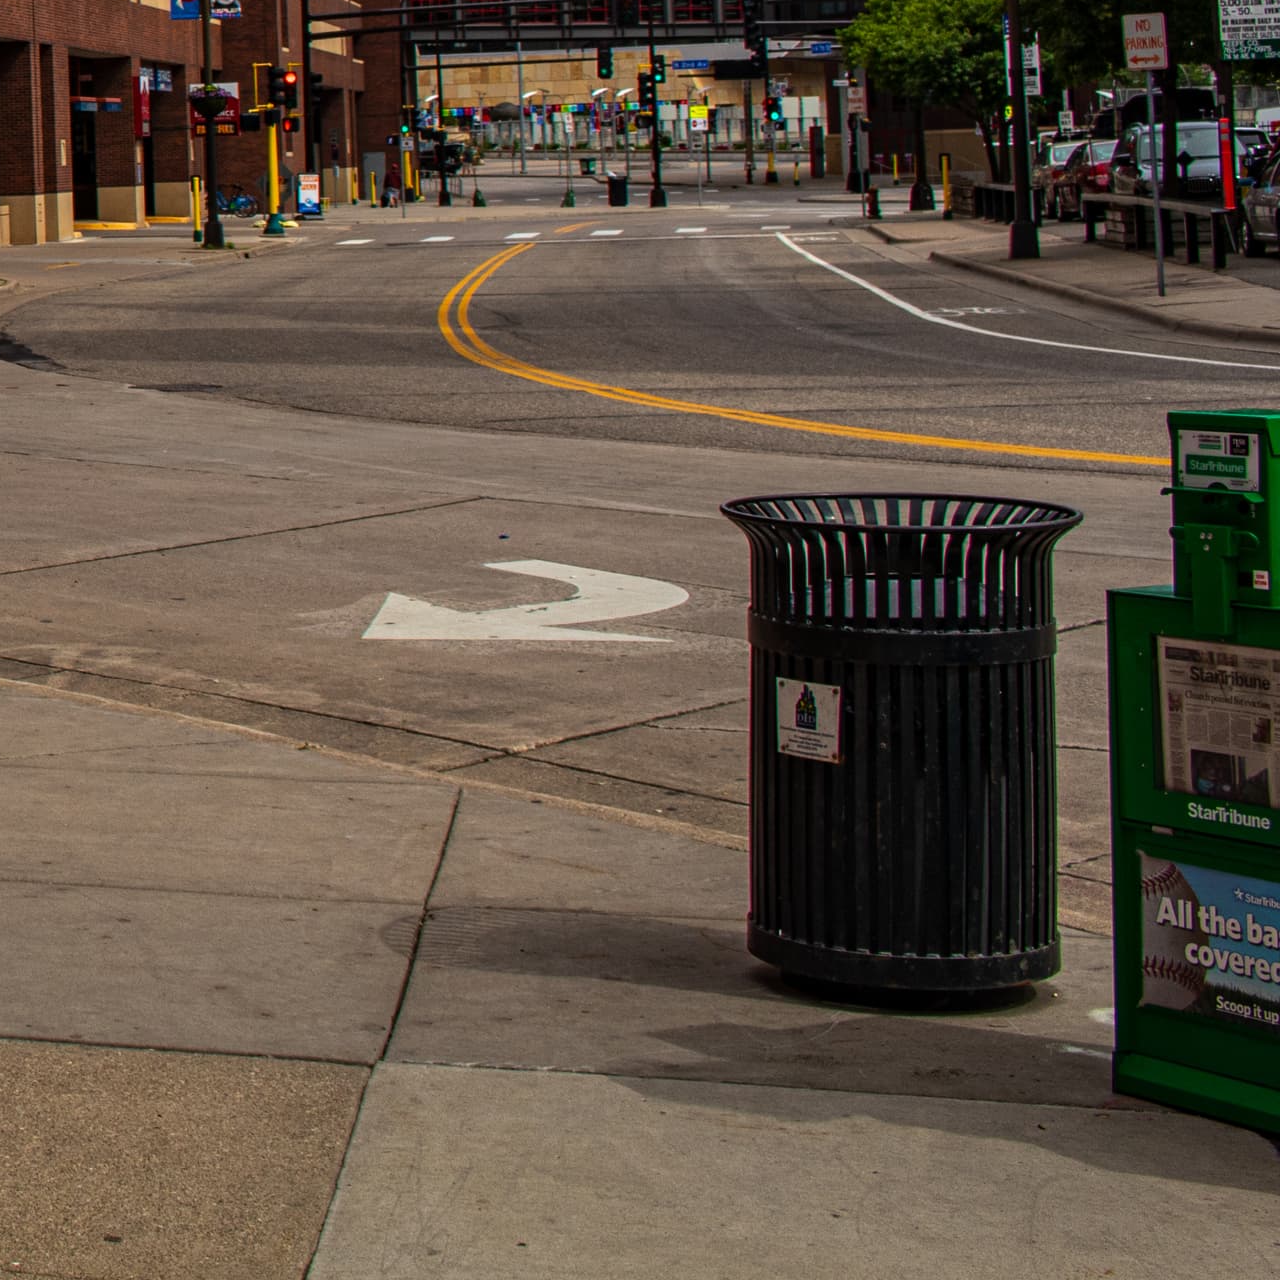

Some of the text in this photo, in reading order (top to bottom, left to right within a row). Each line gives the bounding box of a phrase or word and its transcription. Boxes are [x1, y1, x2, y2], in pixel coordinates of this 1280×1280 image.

[1135, 19, 1151, 32] NO
[1126, 36, 1163, 50] PARKING
[1189, 459, 1245, 473] StarTribune
[1189, 666, 1271, 691] StarTribune
[1187, 801, 1271, 830] StarTribune
[1156, 896, 1280, 949] All the ba
[1215, 995, 1280, 1025] Scoop it up
